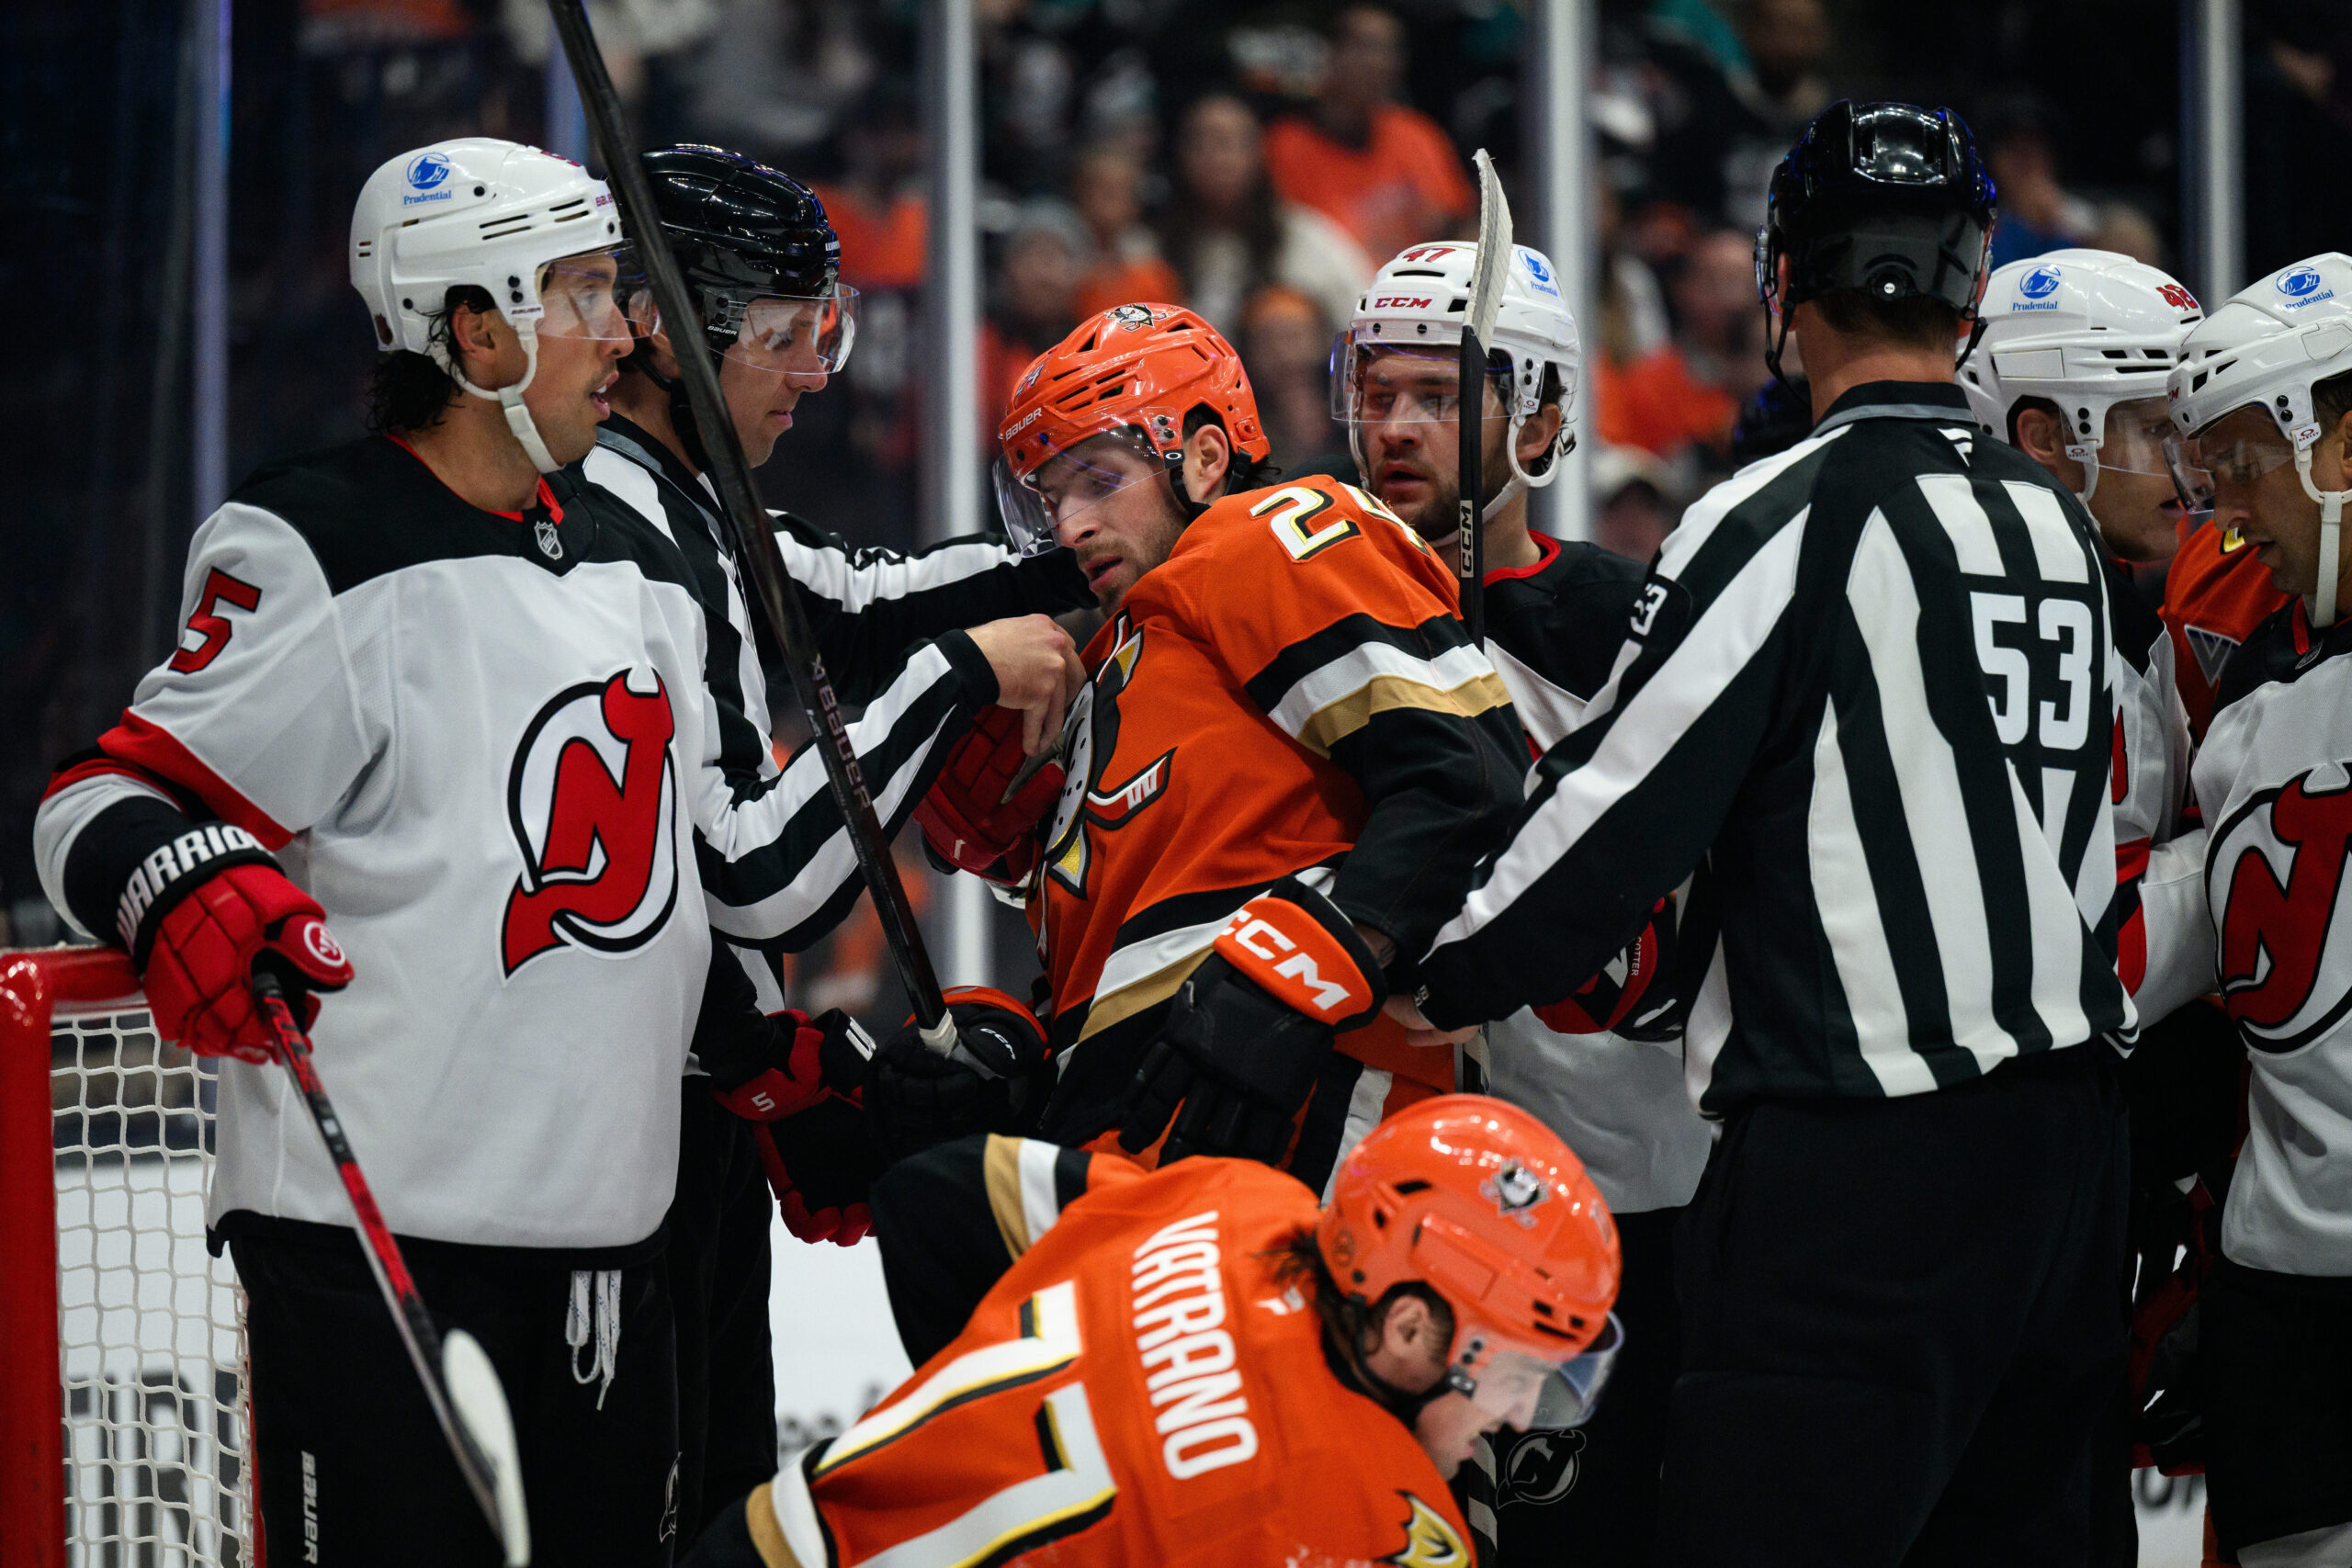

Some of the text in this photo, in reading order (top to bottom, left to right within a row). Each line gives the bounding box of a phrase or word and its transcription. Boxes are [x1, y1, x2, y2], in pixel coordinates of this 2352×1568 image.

[403, 190, 452, 205] Prudential
[1403, 247, 1455, 263] 47
[1374, 298, 1432, 309] CCM
[1530, 280, 1559, 298] Prudential
[2155, 284, 2199, 310] 48
[2285, 289, 2335, 310] Prudential
[2012, 301, 2058, 311] Prudential
[707, 325, 738, 335] BAUER
[1005, 407, 1042, 442] BAUER
[1462, 505, 1473, 574] CCM
[167, 566, 263, 674] 5
[1970, 591, 2093, 751] 53
[819, 684, 872, 809] BAUER
[1131, 1210, 1259, 1480] VATRANO
[812, 1279, 1118, 1568] 77
[300, 1450, 319, 1564] BAUER
